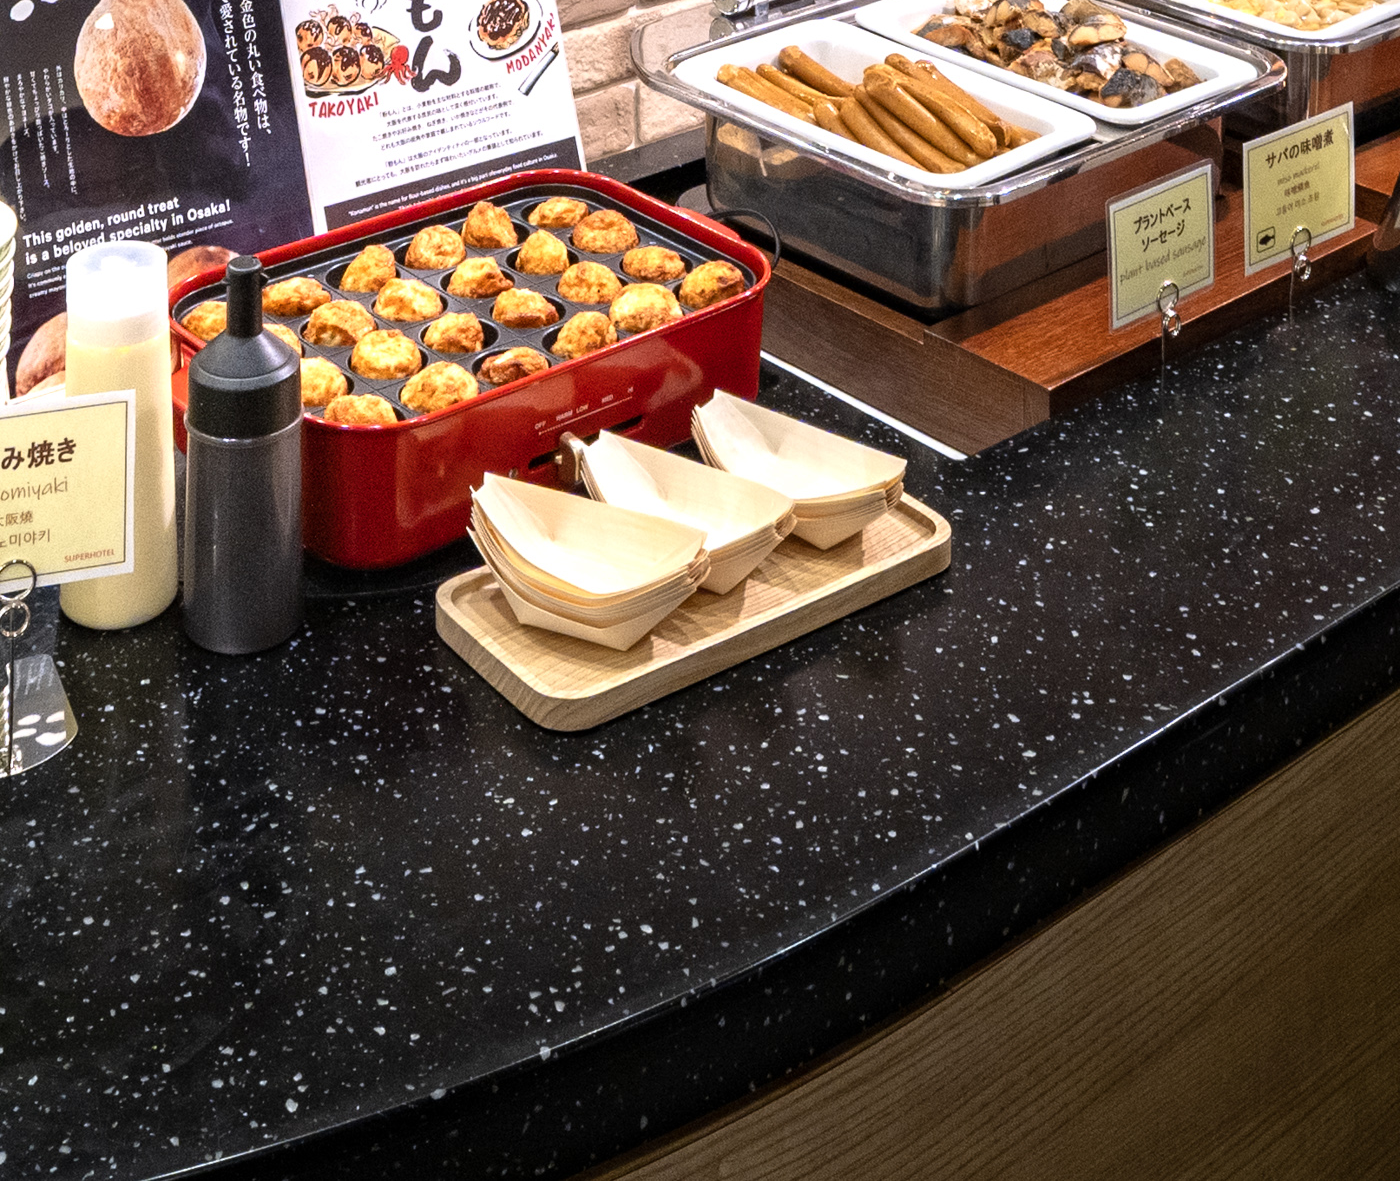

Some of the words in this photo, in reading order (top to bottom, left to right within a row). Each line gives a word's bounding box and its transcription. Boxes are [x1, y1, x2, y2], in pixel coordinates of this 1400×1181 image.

[308, 91, 379, 119] TAKOYAKI
[1265, 128, 1335, 169] サバの味噌煮
[22, 231, 52, 249] This
[55, 218, 105, 243] golden,
[107, 204, 146, 227] round
[147, 196, 180, 216] treat
[25, 252, 38, 266] is
[41, 248, 50, 260] a
[53, 234, 105, 259] beloved
[109, 216, 168, 243] specialty
[171, 212, 184, 227] in
[187, 198, 231, 222] Osaka!
[1133, 197, 1192, 235] プラントベース
[1141, 219, 1185, 253] ソーセージ
[64, 548, 115, 563] SUPERHOTEL
